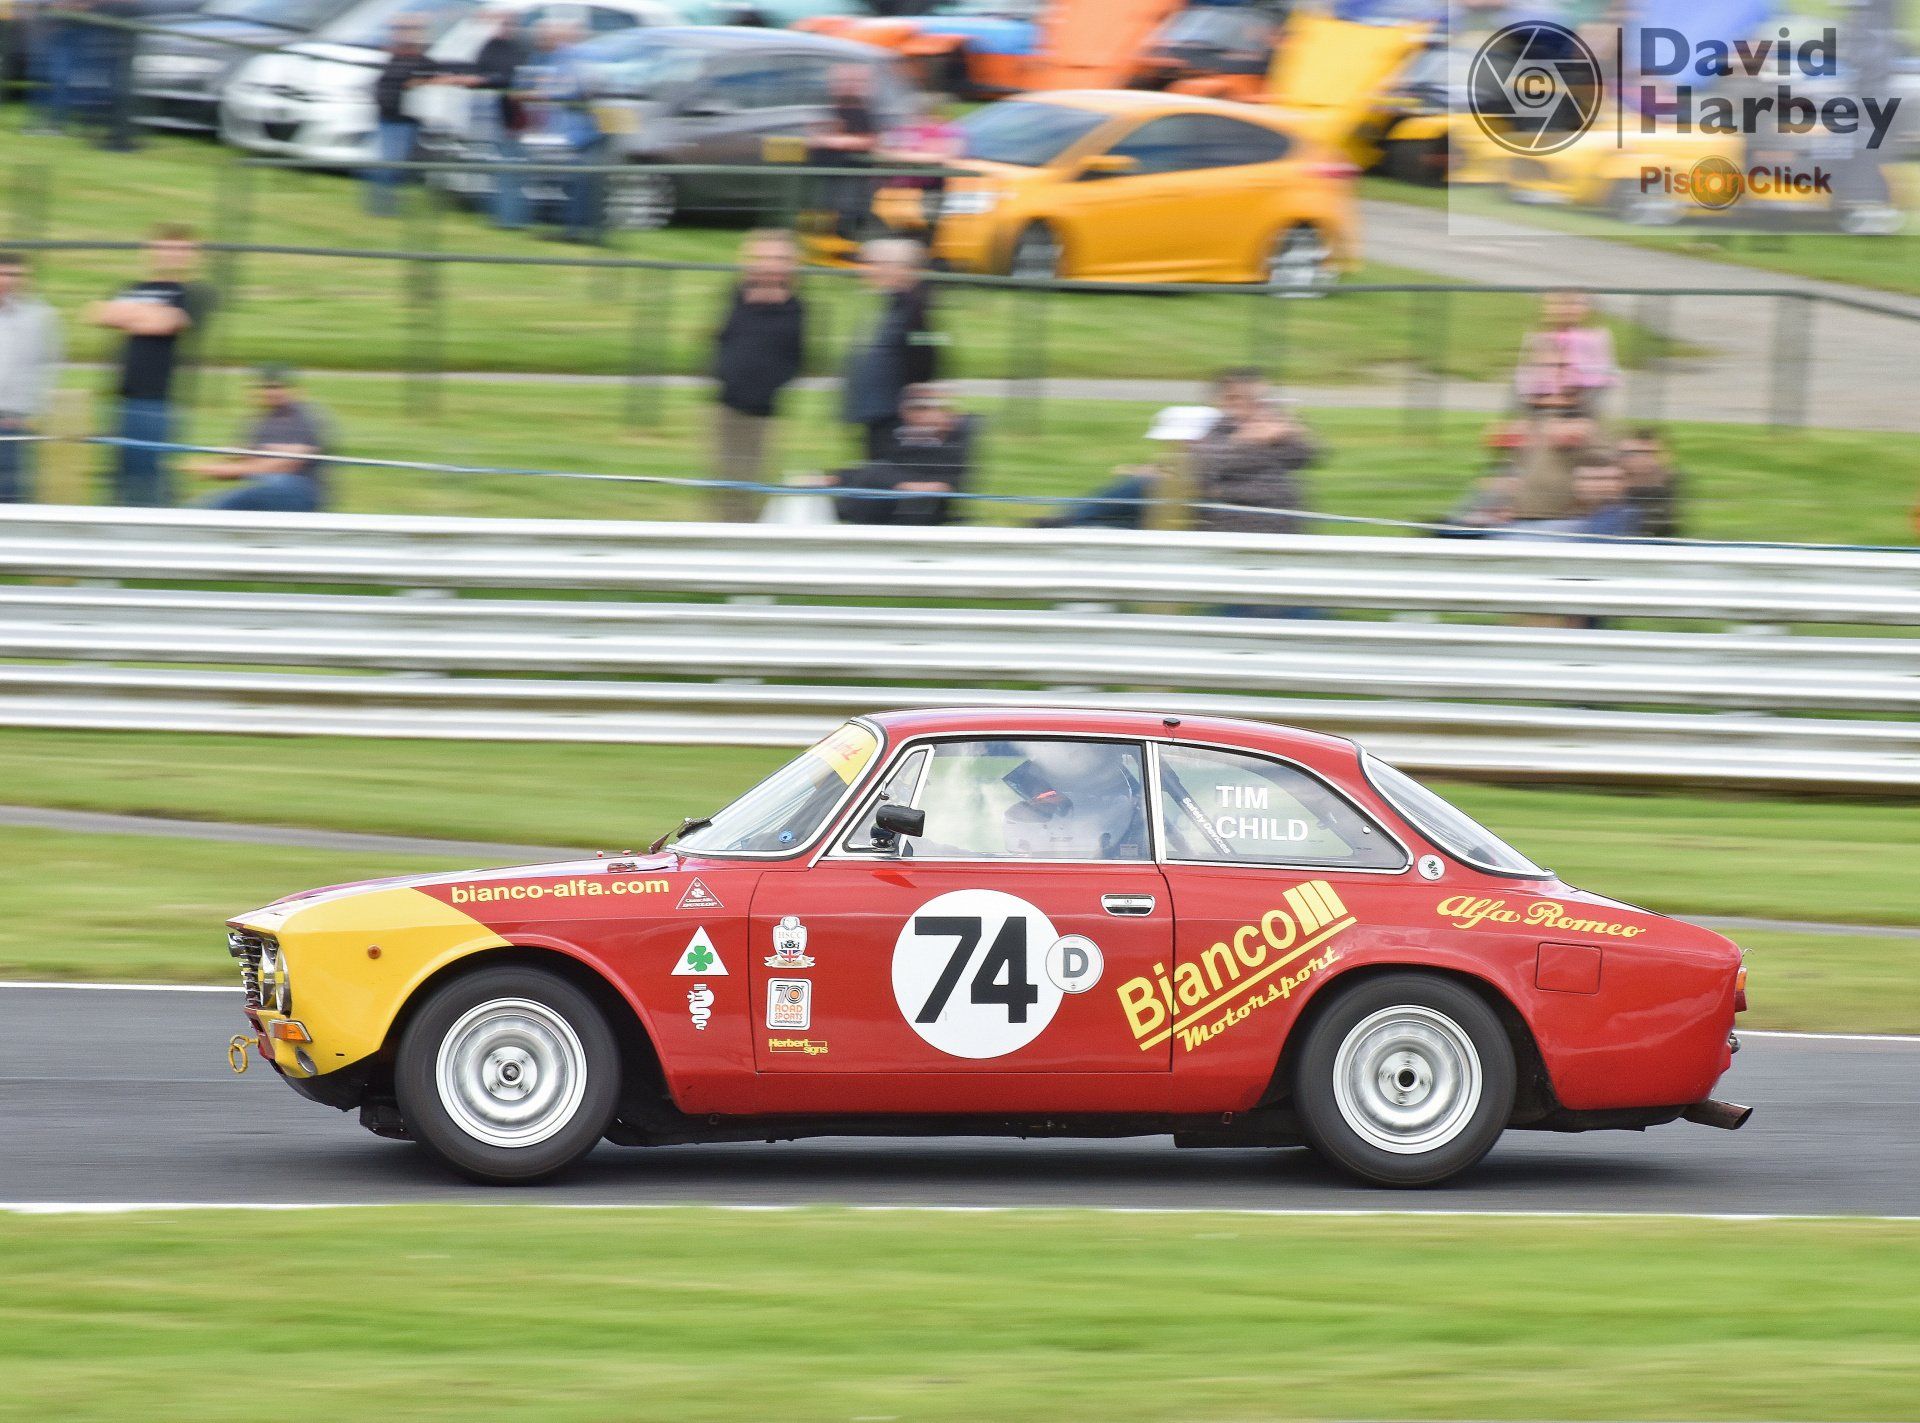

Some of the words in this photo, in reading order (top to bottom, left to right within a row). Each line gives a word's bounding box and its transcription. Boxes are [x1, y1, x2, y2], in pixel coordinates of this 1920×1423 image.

[1215, 785, 1269, 810] TIM
[1215, 816, 1309, 842] CHILD
[451, 877, 670, 904] bianco-alfa.com
[1436, 895, 1521, 929] Alfa
[1524, 901, 1647, 938] Romeo
[914, 916, 1038, 1024] 74
[1062, 947, 1089, 978] D
[1116, 909, 1297, 1040] Bianco
[775, 1004, 803, 1013] ROAD
[1176, 945, 1341, 1052] Motorsport
[774, 1012, 803, 1020] SPORTS
[768, 1038, 810, 1048] Herbert
[803, 1046, 829, 1055] signs
